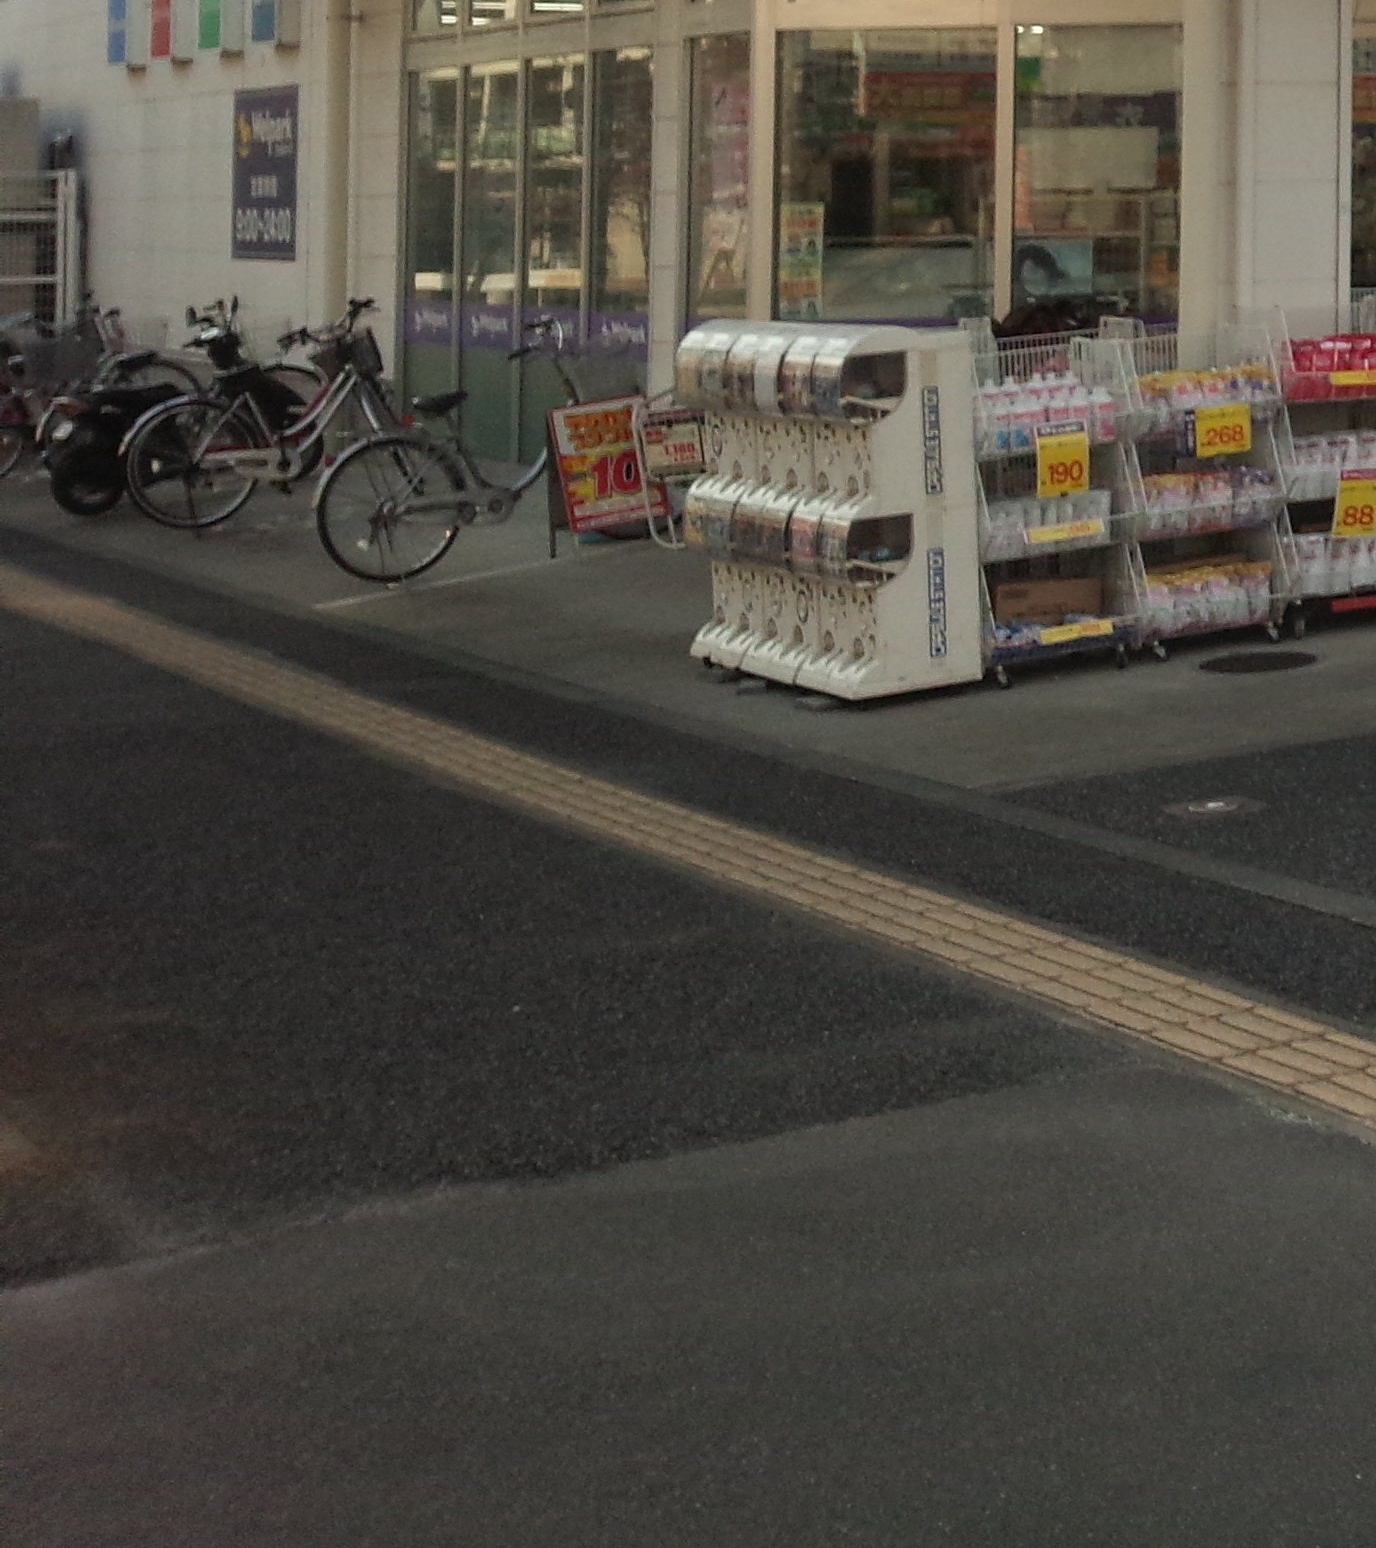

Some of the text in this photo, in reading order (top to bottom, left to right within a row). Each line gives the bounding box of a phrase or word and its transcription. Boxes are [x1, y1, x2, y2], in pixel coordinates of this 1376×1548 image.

[1206, 424, 1244, 447] 268
[1048, 459, 1084, 485] 190
[1342, 504, 1375, 526] 88
